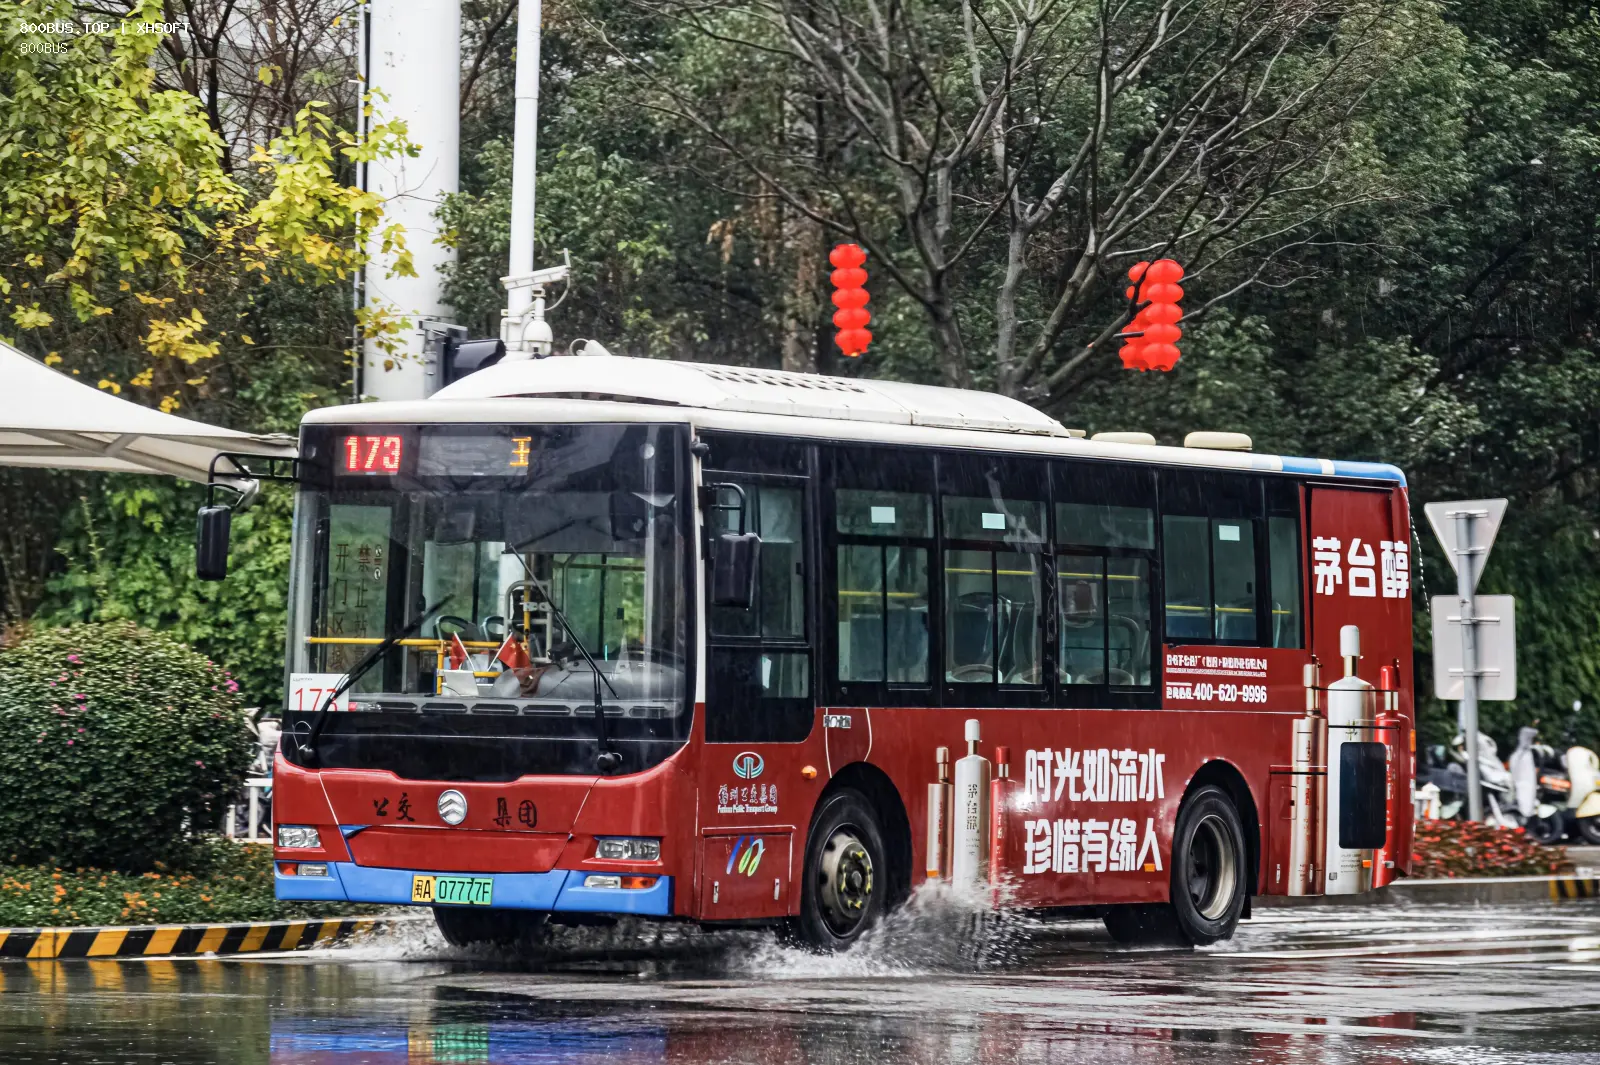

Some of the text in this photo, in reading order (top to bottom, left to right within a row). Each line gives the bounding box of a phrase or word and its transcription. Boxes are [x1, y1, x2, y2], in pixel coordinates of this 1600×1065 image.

[345, 435, 402, 470] 173
[1312, 536, 1410, 599] 茅台醇
[1193, 682, 1268, 704] 400-620-9996
[1024, 747, 1166, 803] 时光如流水
[373, 792, 416, 822] 公交
[1023, 817, 1164, 875] 珍惜有缘人
